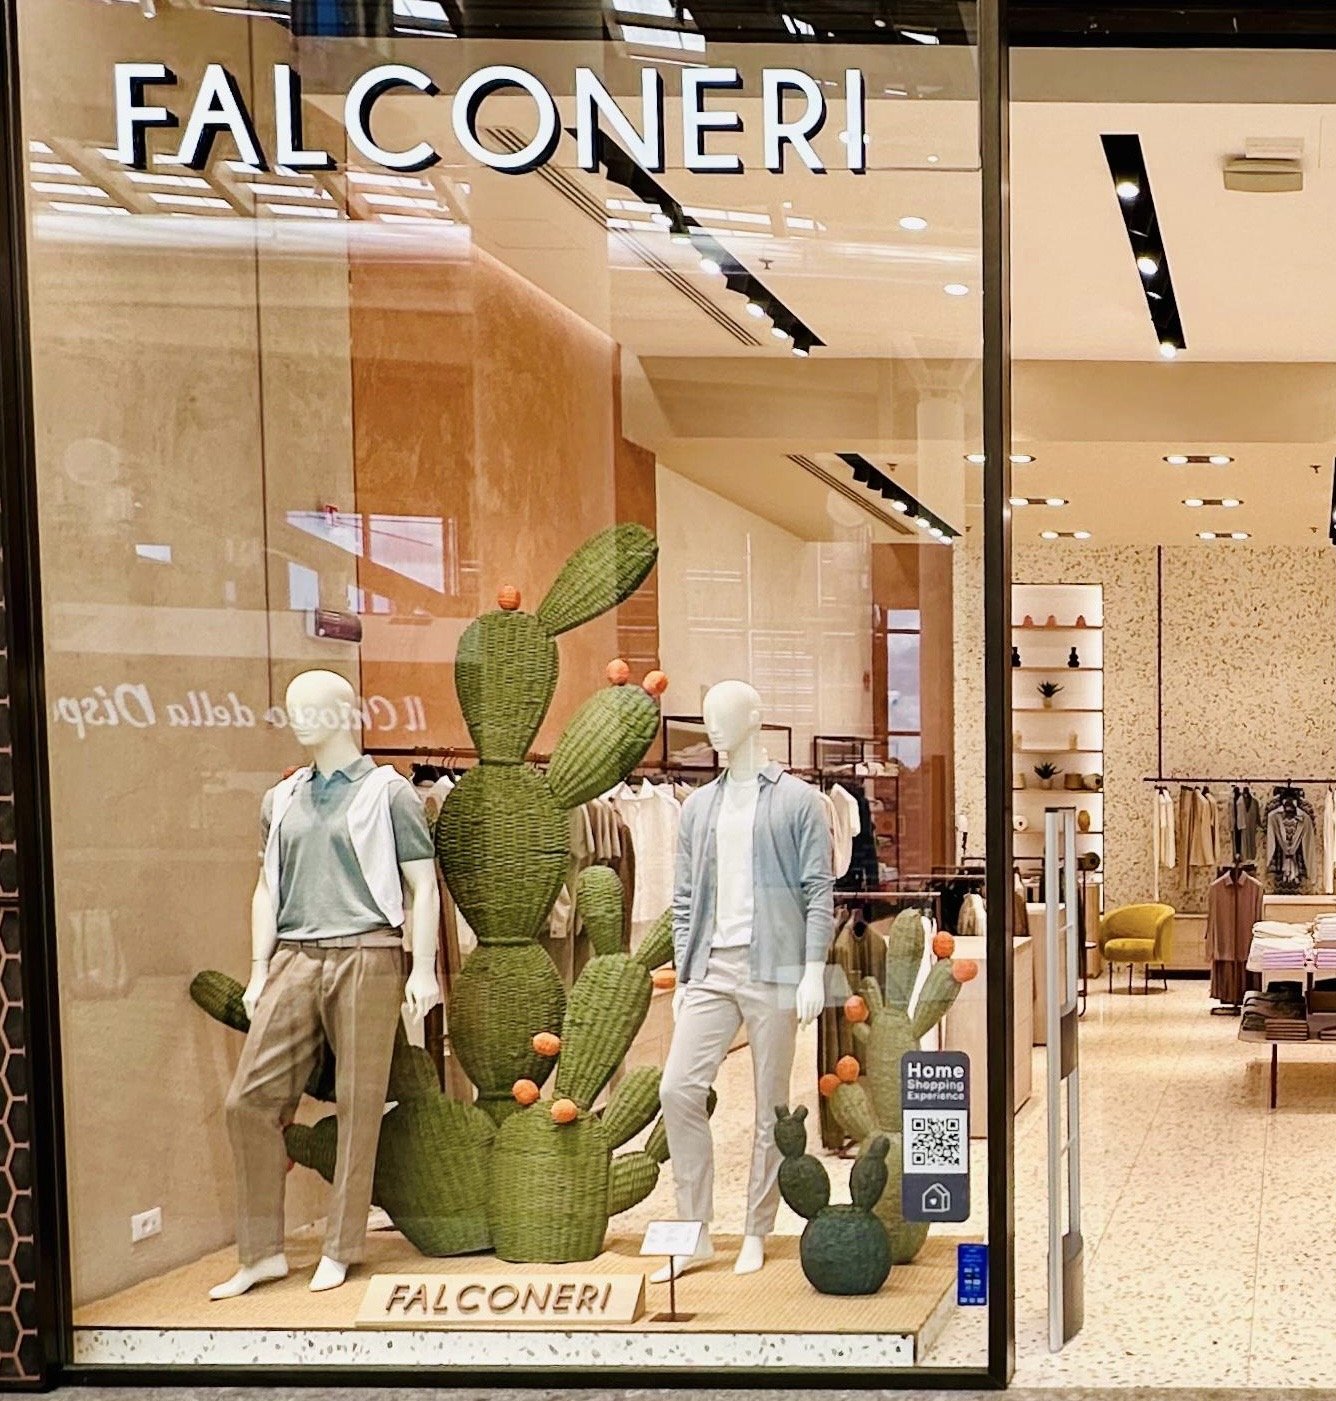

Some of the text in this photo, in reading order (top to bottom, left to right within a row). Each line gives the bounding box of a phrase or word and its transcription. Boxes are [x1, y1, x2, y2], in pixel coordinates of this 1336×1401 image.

[112, 62, 868, 175] FALCONERI
[908, 1062, 965, 1078] Home
[907, 1079, 965, 1092] Shopping
[907, 1090, 965, 1102] Experience
[385, 1283, 613, 1315] FALCONERI
